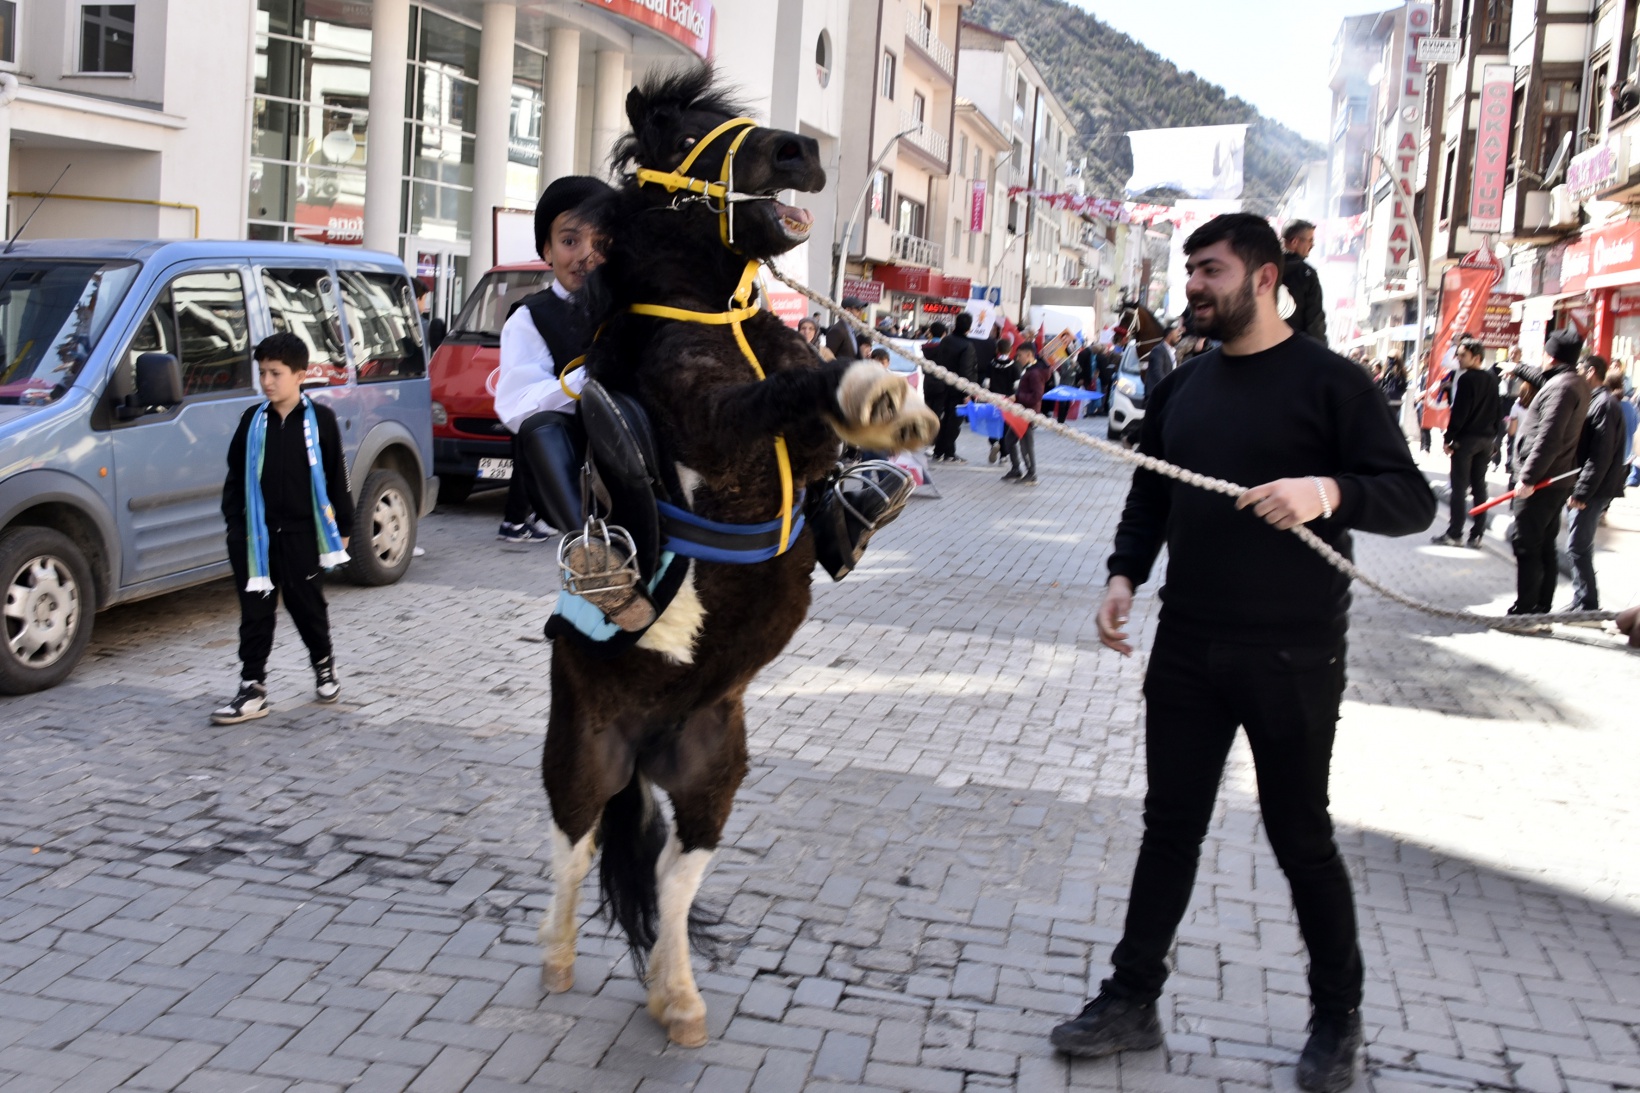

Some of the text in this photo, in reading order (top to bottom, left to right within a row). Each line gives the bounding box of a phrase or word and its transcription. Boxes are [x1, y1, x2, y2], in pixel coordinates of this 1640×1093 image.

[1406, 9, 1428, 96] OTEL
[1422, 40, 1457, 48] AVUKAT
[1389, 132, 1416, 265] ATALAY
[1478, 86, 1507, 217] GÖKAY TUR
